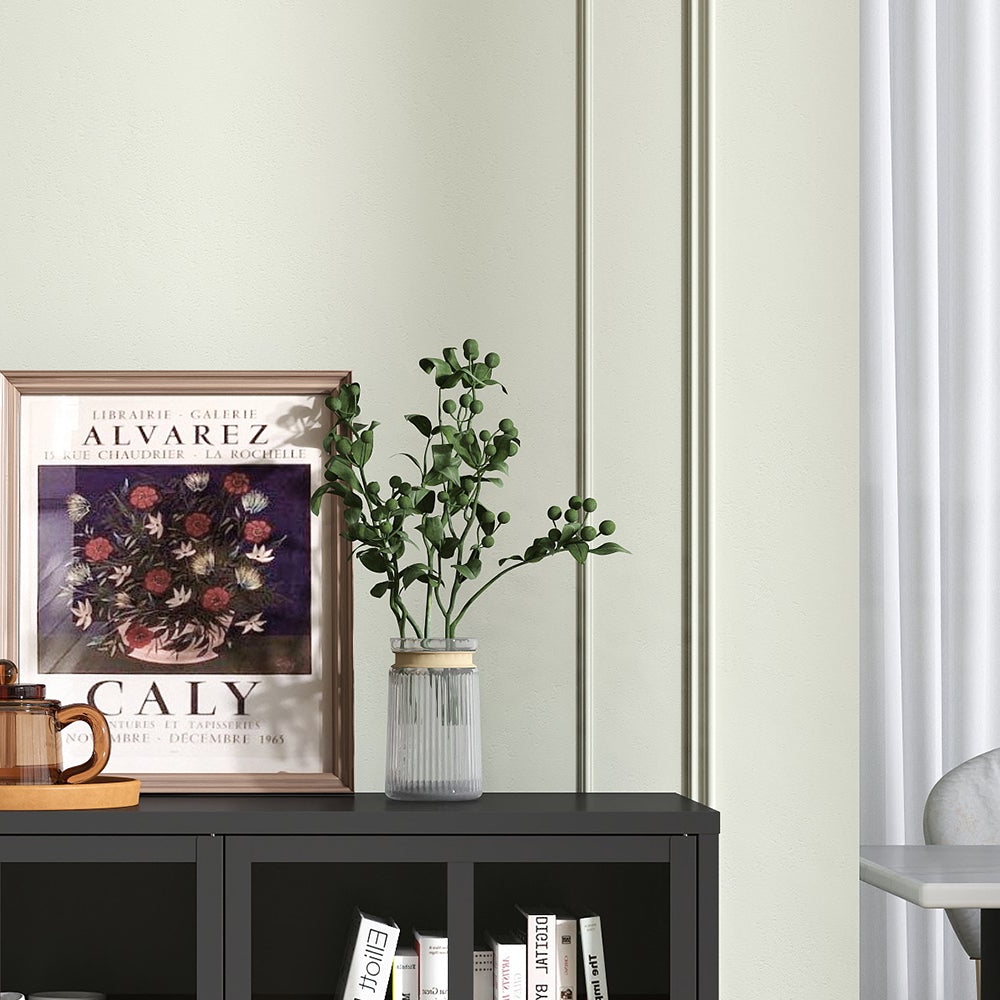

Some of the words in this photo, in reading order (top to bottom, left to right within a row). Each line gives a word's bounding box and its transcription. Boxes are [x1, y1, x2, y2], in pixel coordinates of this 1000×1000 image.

[93, 410, 172, 420] LIBRAIRIE
[191, 409, 257, 420] GALERIE
[82, 424, 269, 446] ALVAREZ
[63, 451, 90, 460] RUE
[98, 450, 185, 460] CHAUDRIER
[206, 450, 222, 460] LA
[231, 449, 306, 460] ROCHELLE
[87, 680, 262, 716] CALY
[108, 720, 155, 730] NTURES
[165, 720, 178, 730] ET
[66, 732, 150, 744] NOMBRE
[260, 735, 285, 744] 1965
